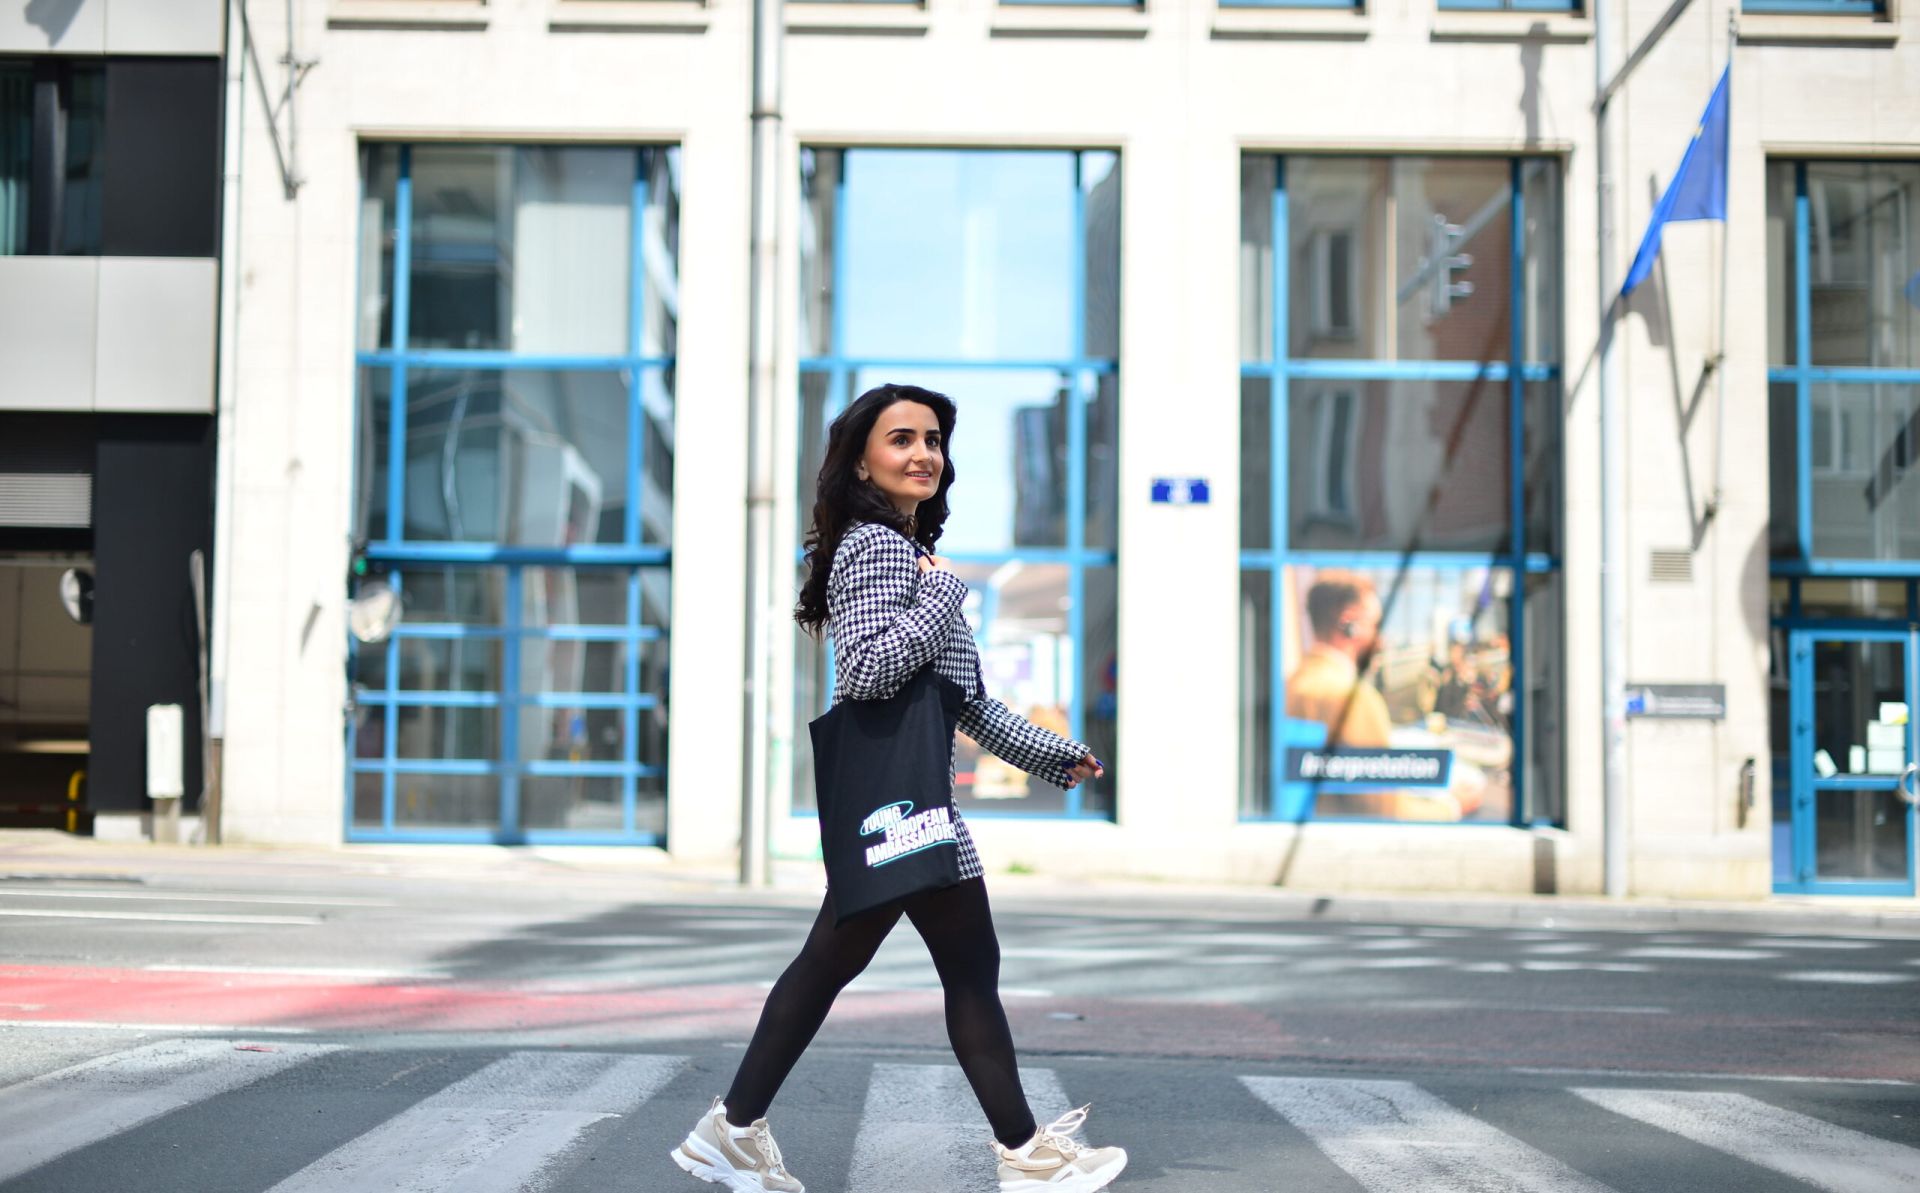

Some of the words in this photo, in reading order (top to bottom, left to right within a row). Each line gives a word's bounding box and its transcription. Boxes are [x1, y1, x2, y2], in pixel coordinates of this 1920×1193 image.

[1301, 752, 1440, 782] Interpretation
[863, 805, 902, 833] YOUNG
[885, 806, 950, 842] EUROPEAN
